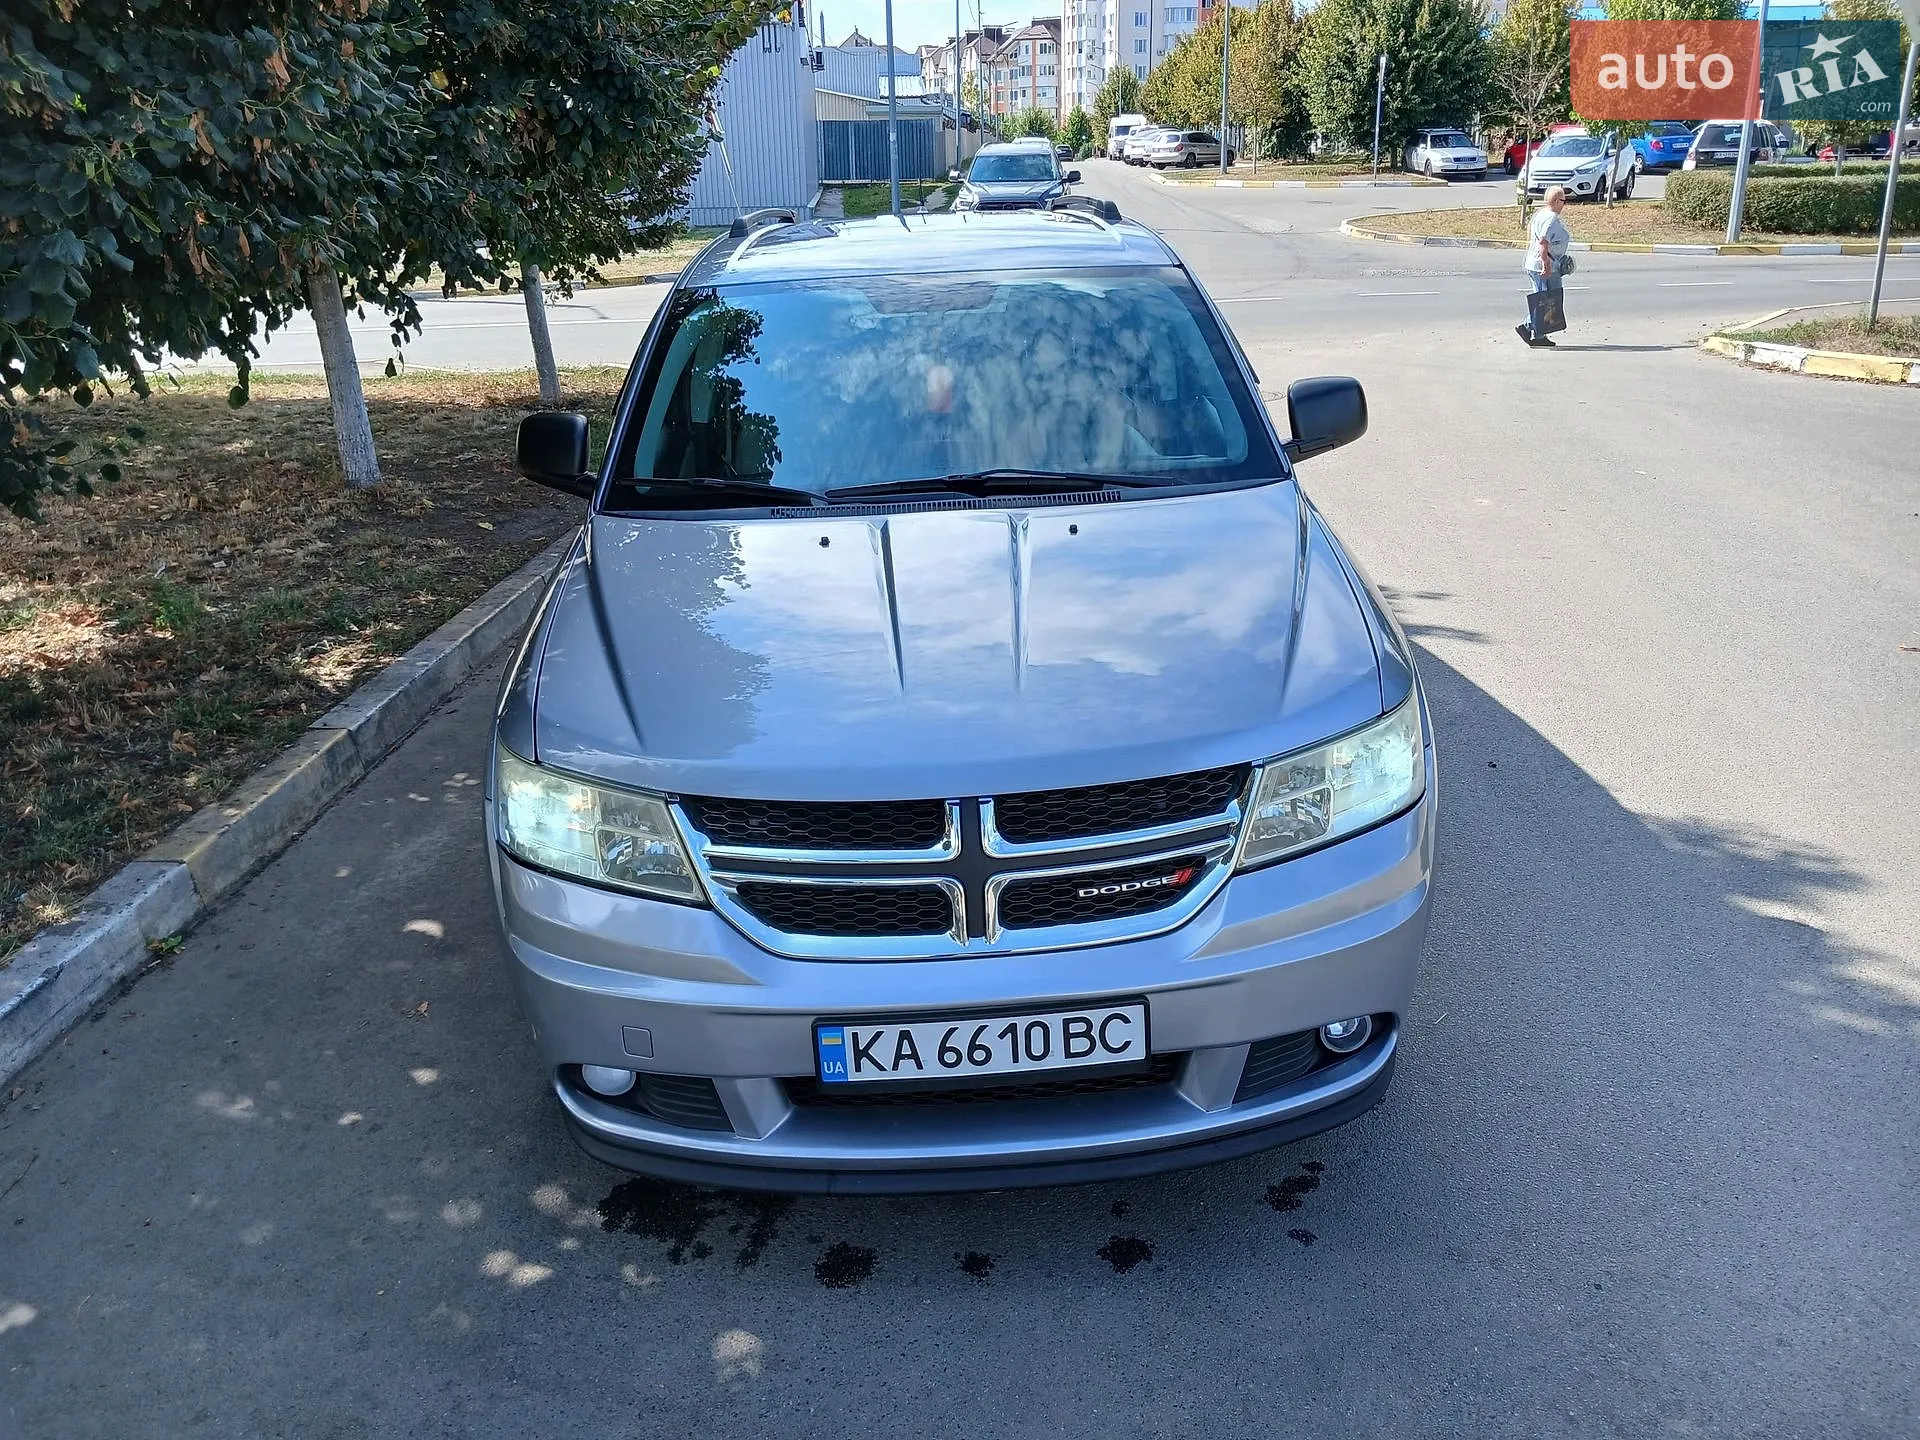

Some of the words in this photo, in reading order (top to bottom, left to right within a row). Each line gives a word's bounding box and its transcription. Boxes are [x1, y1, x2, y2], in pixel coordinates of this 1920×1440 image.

[1079, 874, 1179, 897] DODGE
[851, 1029, 924, 1073] KA
[937, 1020, 1051, 1069] 6610
[1062, 1012, 1133, 1059] BC
[823, 1061, 845, 1074] UA
